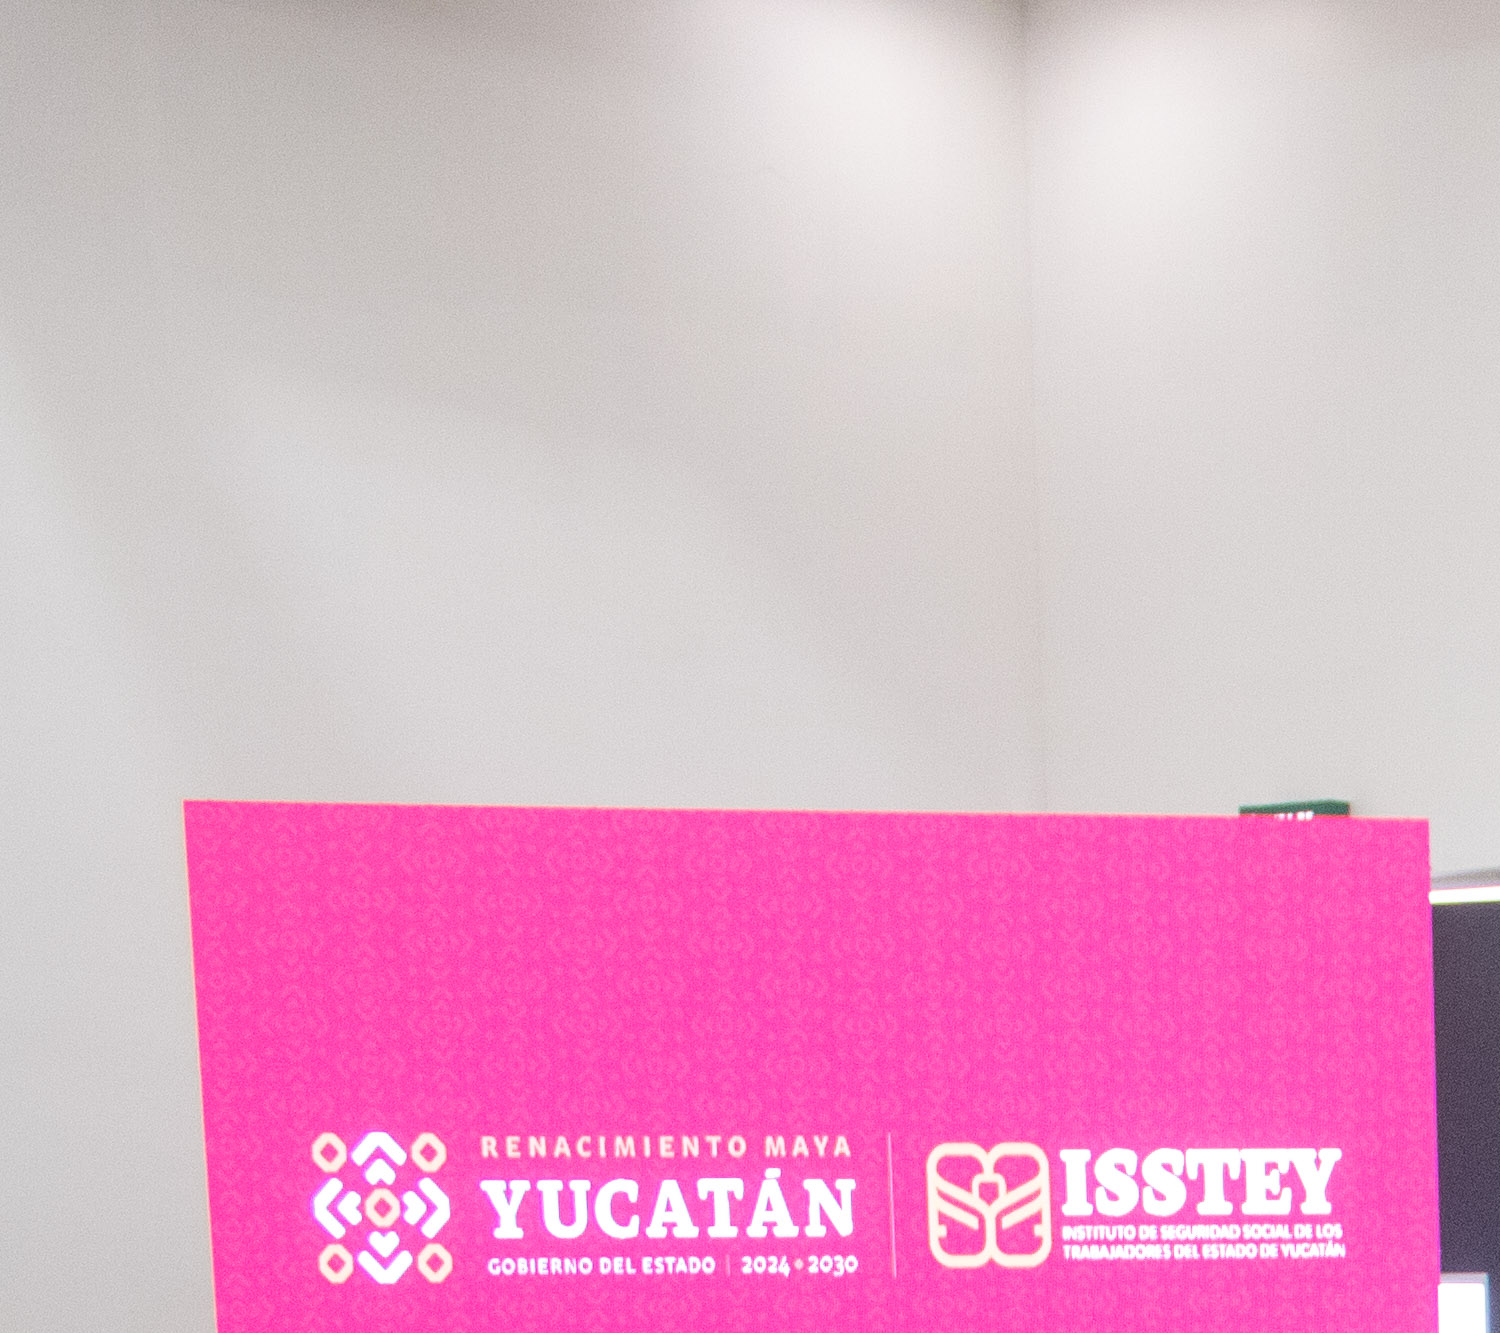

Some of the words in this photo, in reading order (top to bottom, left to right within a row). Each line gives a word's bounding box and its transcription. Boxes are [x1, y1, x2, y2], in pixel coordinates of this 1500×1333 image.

[480, 1135, 747, 1158] RENACIMIENTO
[764, 1135, 852, 1158] MAYA
[1059, 1147, 1342, 1217] ISSTEY
[479, 1168, 857, 1240] YUCATÁN
[1061, 1225, 1136, 1241] INSTITUTO
[1139, 1225, 1157, 1241] DE
[1160, 1224, 1241, 1240] SEGURIDAD
[1243, 1224, 1292, 1240] SOCIAL
[1294, 1224, 1313, 1239] DE
[1316, 1223, 1343, 1239] LOS
[1063, 1244, 1171, 1260] TRABAJADORES
[1173, 1244, 1199, 1259] DEL
[1202, 1244, 1258, 1259] ESTADO
[1260, 1243, 1278, 1258] DE
[1280, 1241, 1346, 1259] YUCATÁN
[487, 1257, 593, 1276] GOBIERNO
[599, 1256, 636, 1275] DEL
[642, 1256, 716, 1275] ESTADO
